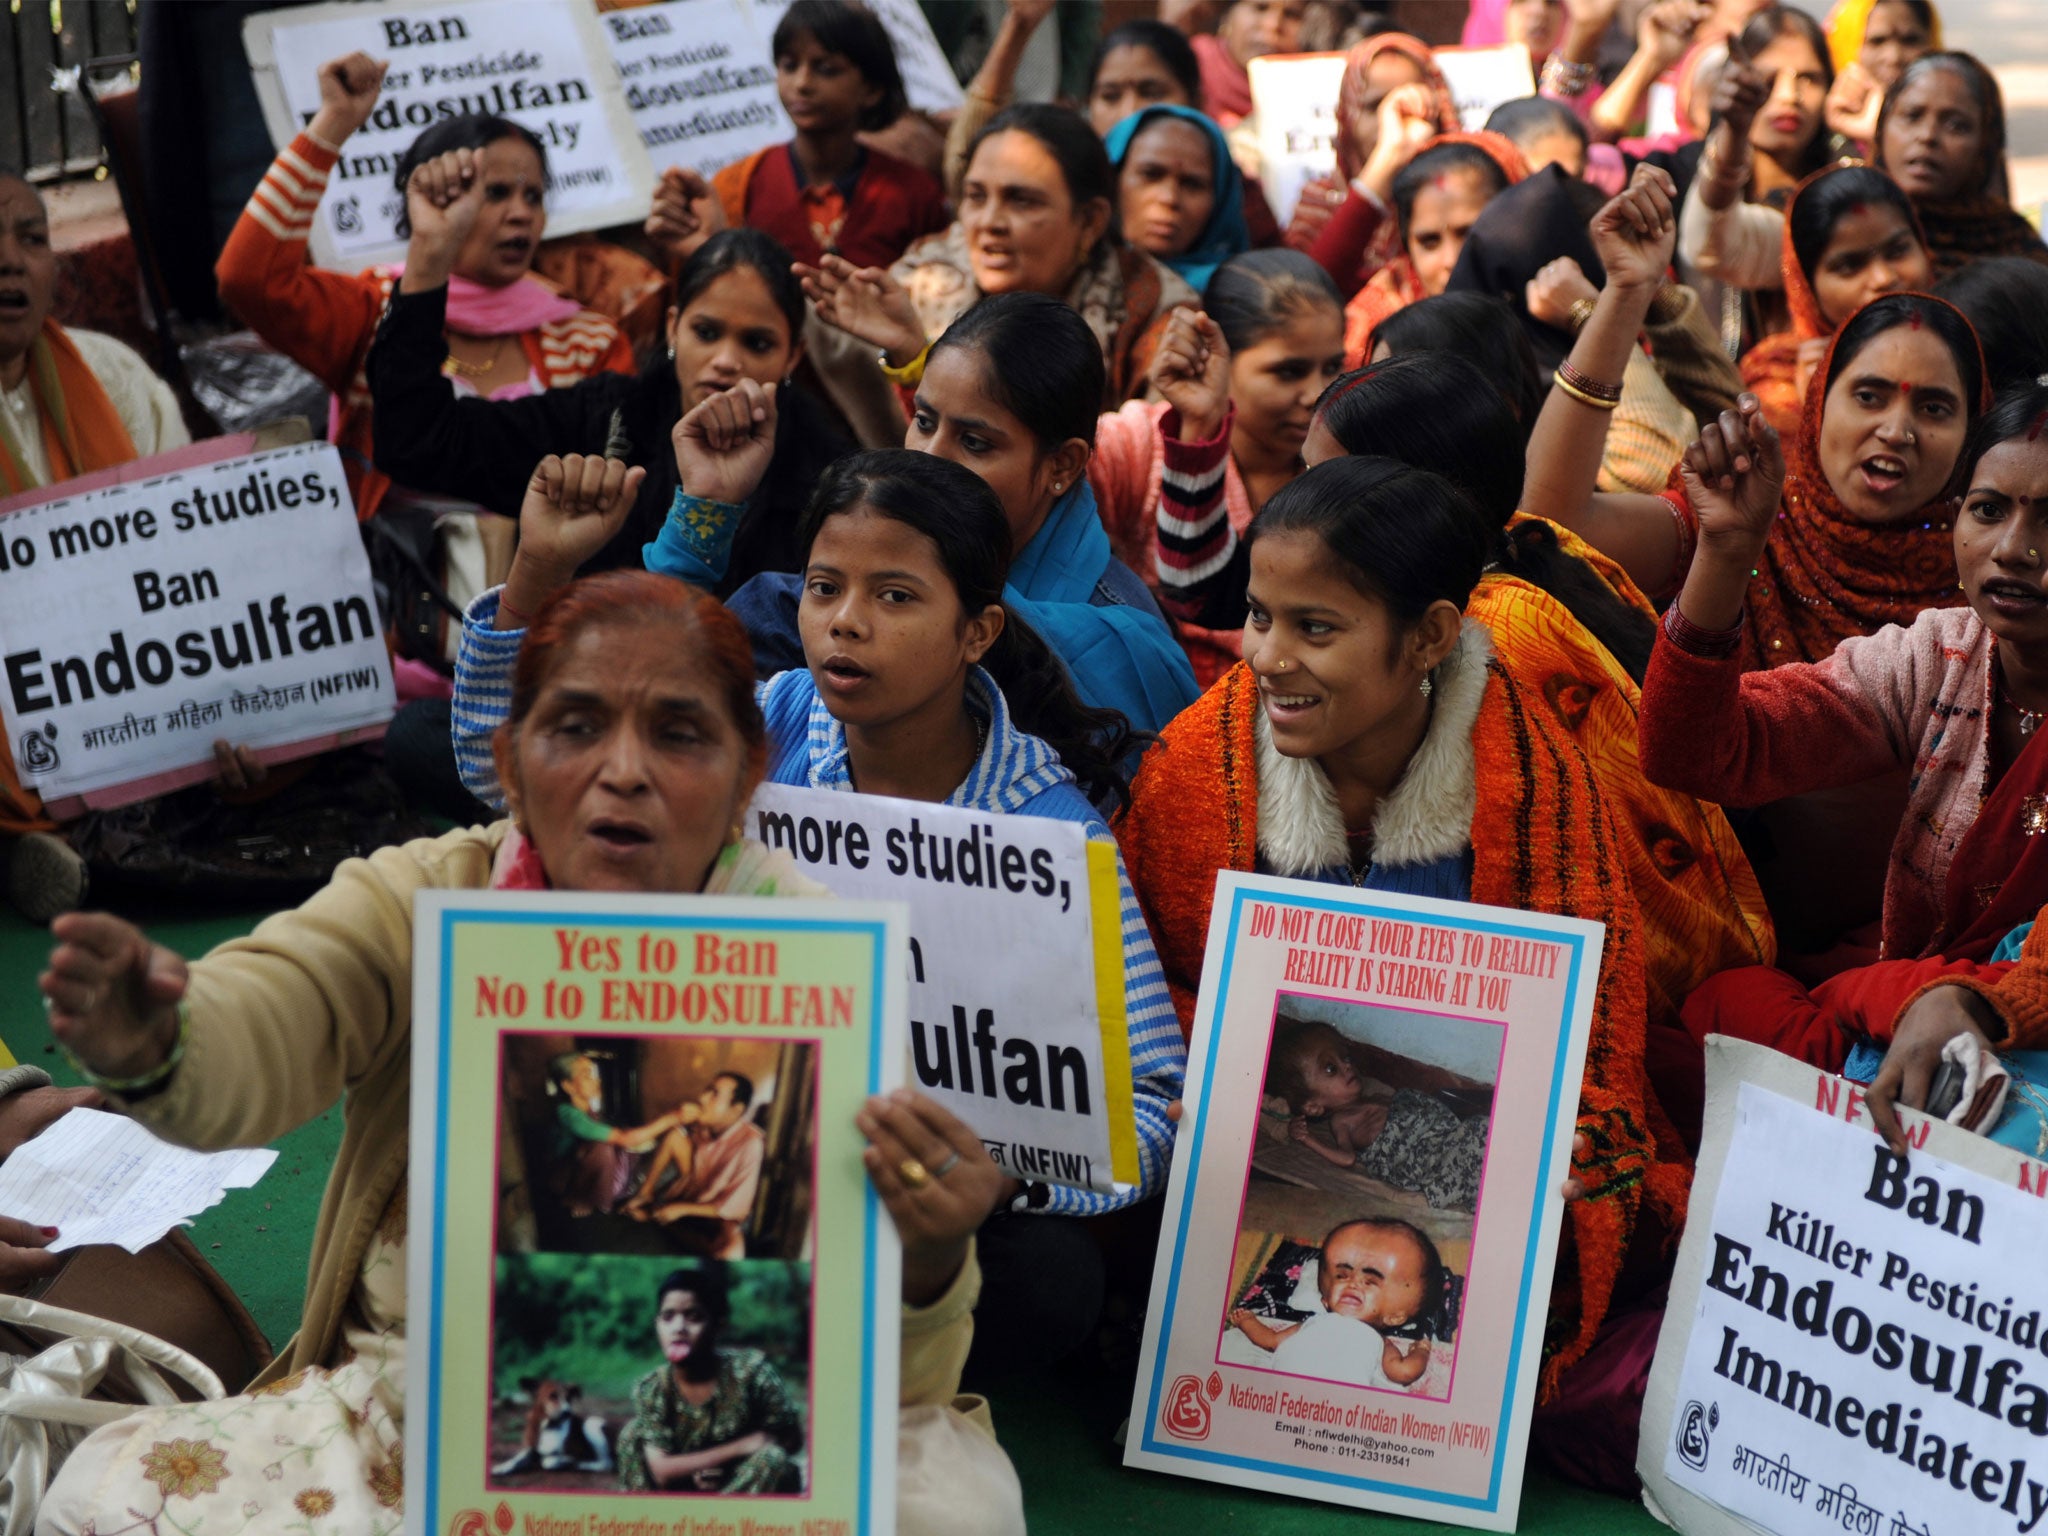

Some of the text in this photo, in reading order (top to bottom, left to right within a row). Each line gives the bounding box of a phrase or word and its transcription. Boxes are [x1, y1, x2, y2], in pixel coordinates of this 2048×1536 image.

[381, 15, 468, 49] Ban
[607, 12, 673, 41] Ban
[421, 50, 543, 86] Pesticide
[648, 43, 732, 70] Pesticide
[302, 77, 589, 132] dosulfan
[626, 65, 776, 110] dosulfan
[638, 100, 777, 147] mmediately
[48, 508, 158, 559] more
[171, 469, 340, 532] studies,
[133, 567, 219, 614] Ban
[3, 592, 375, 716] Endosulfan
[82, 711, 158, 750] भारतीय
[163, 699, 225, 732] महिला
[310, 666, 380, 705] (NFIW)
[758, 810, 1071, 912] more studies,
[553, 929, 779, 978] Yes to Ban
[1249, 904, 1561, 979] DO NOT CLOSE YOUR EYES TO REALITY
[475, 975, 855, 1028] No to ENDOSULFAN
[1284, 948, 1512, 1013] REALITY IS STARING AT YOU
[910, 1004, 1092, 1116] ulfan
[1816, 1073, 1931, 1150] NFW
[1012, 1143, 1093, 1189] (NFIW)
[1864, 1144, 1986, 1246] Ban
[1766, 1201, 1873, 1279] Killer
[1706, 1232, 2048, 1437] Endosulfa
[1228, 1383, 1492, 1457] National Federation of Indian Women (NFIW)
[1275, 1421, 1306, 1435] Email
[1315, 1428, 1435, 1458] nfiwdelhi@yahoo.com
[1713, 1325, 2048, 1534] Immediately
[1294, 1438, 1329, 1453] Phone
[1338, 1446, 1411, 1468] 011-23319541
[1732, 1445, 1811, 1503] भारतीय
